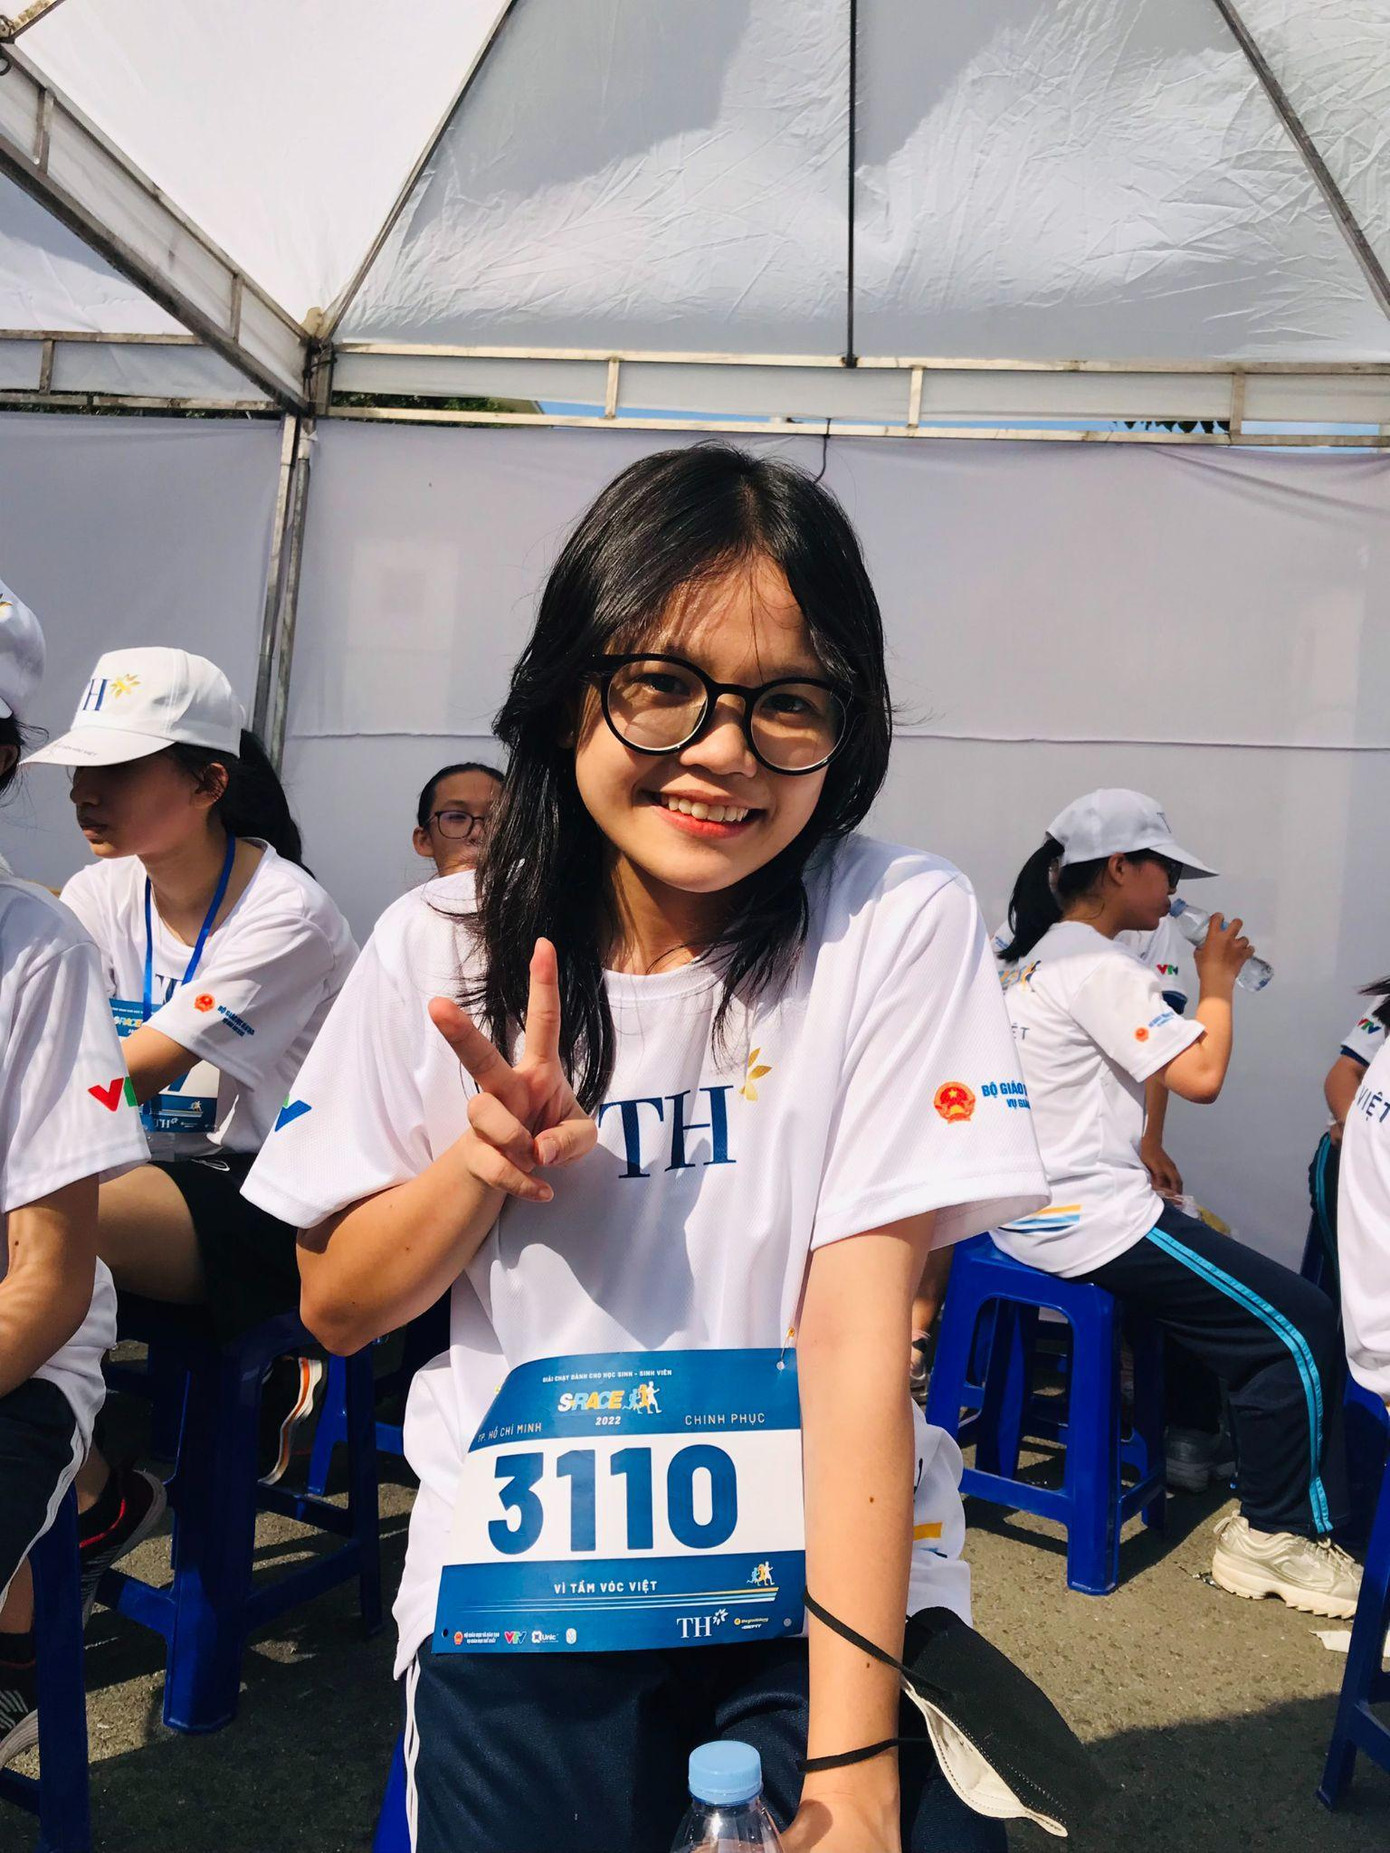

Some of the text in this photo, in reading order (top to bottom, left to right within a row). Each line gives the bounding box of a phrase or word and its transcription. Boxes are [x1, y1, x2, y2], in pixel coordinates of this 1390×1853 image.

[981, 1081, 998, 1098] BỘ
[999, 1079, 1024, 1095] GIÁO
[598, 1085, 737, 1179] TH
[595, 1416, 622, 1426] 2022
[731, 1412, 765, 1426] PHỤC
[516, 1422, 542, 1435] MINH
[488, 1444, 738, 1555] 3110
[628, 1578, 658, 1594] VIỆT
[676, 1615, 712, 1639] TH
